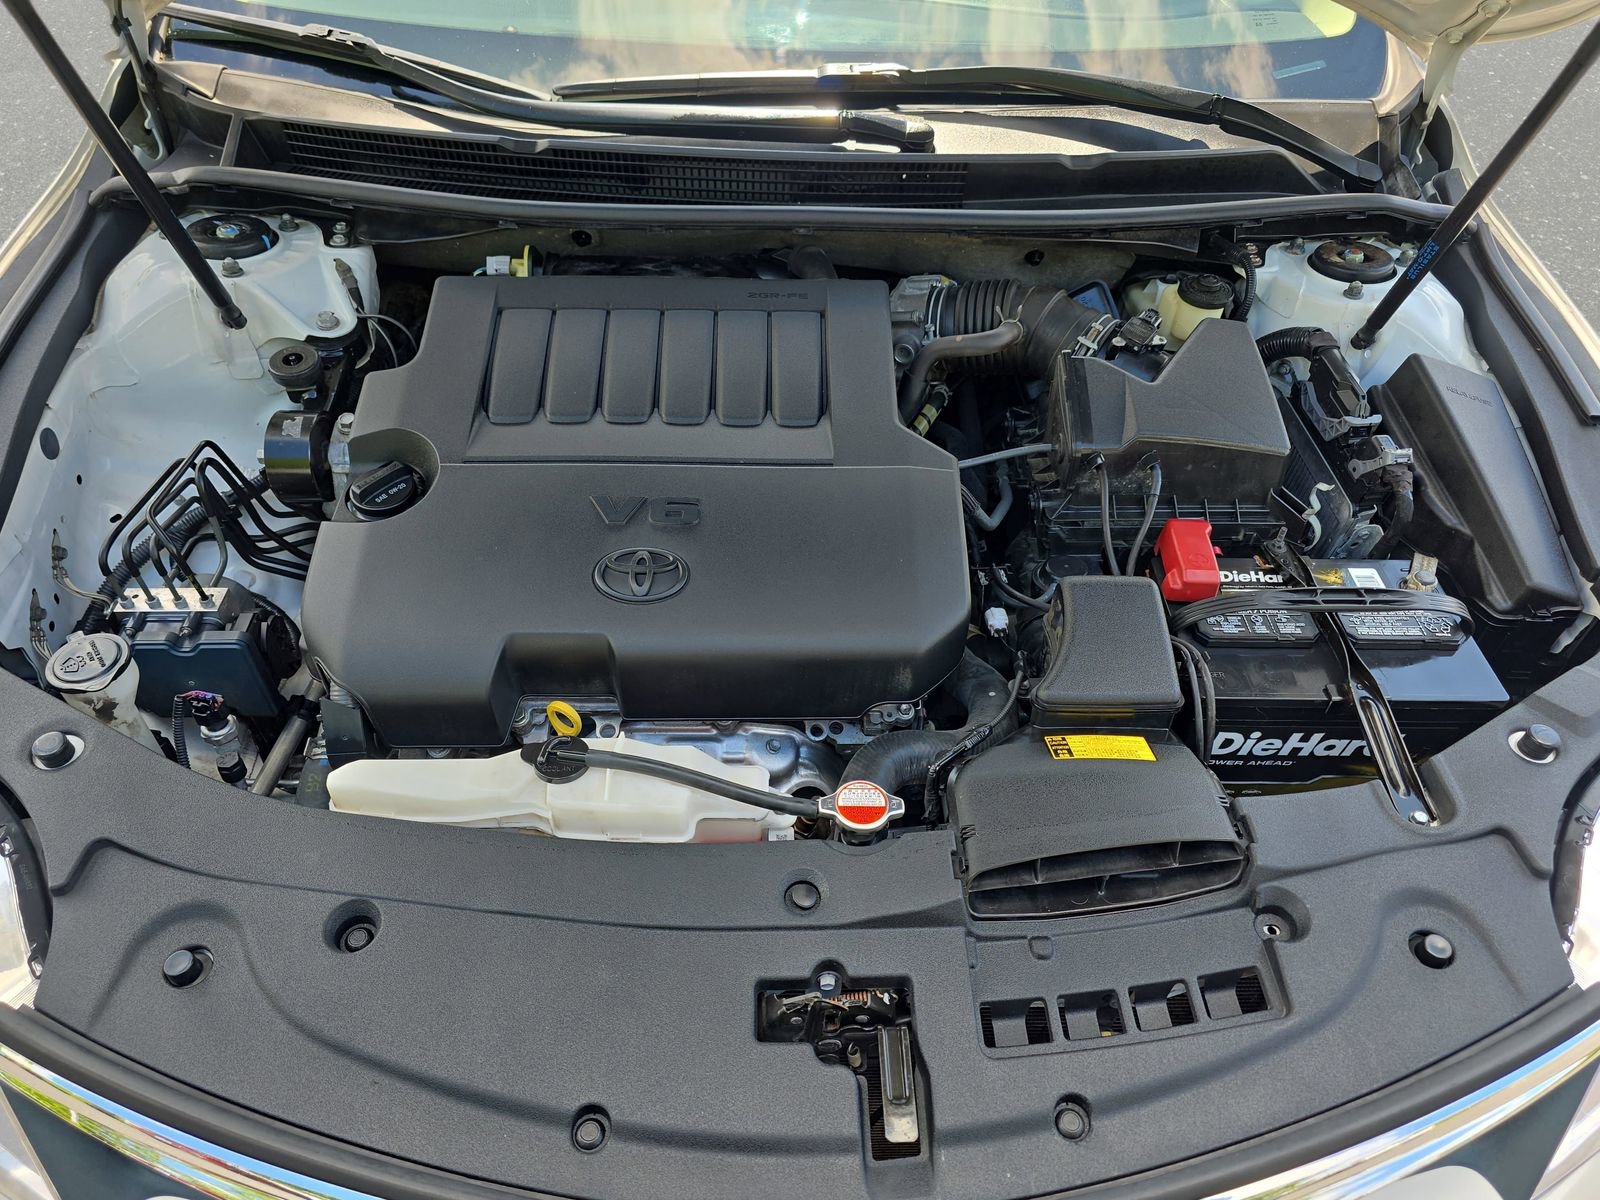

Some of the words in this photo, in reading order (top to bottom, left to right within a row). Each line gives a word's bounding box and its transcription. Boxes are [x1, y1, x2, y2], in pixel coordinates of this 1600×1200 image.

[1410, 244, 1439, 279] STABILUS
[375, 493, 388, 503] SAE
[388, 482, 407, 495] 0W-20
[589, 495, 701, 525] V6
[1219, 570, 1283, 582] DieHar
[1211, 731, 1372, 757] DieHar
